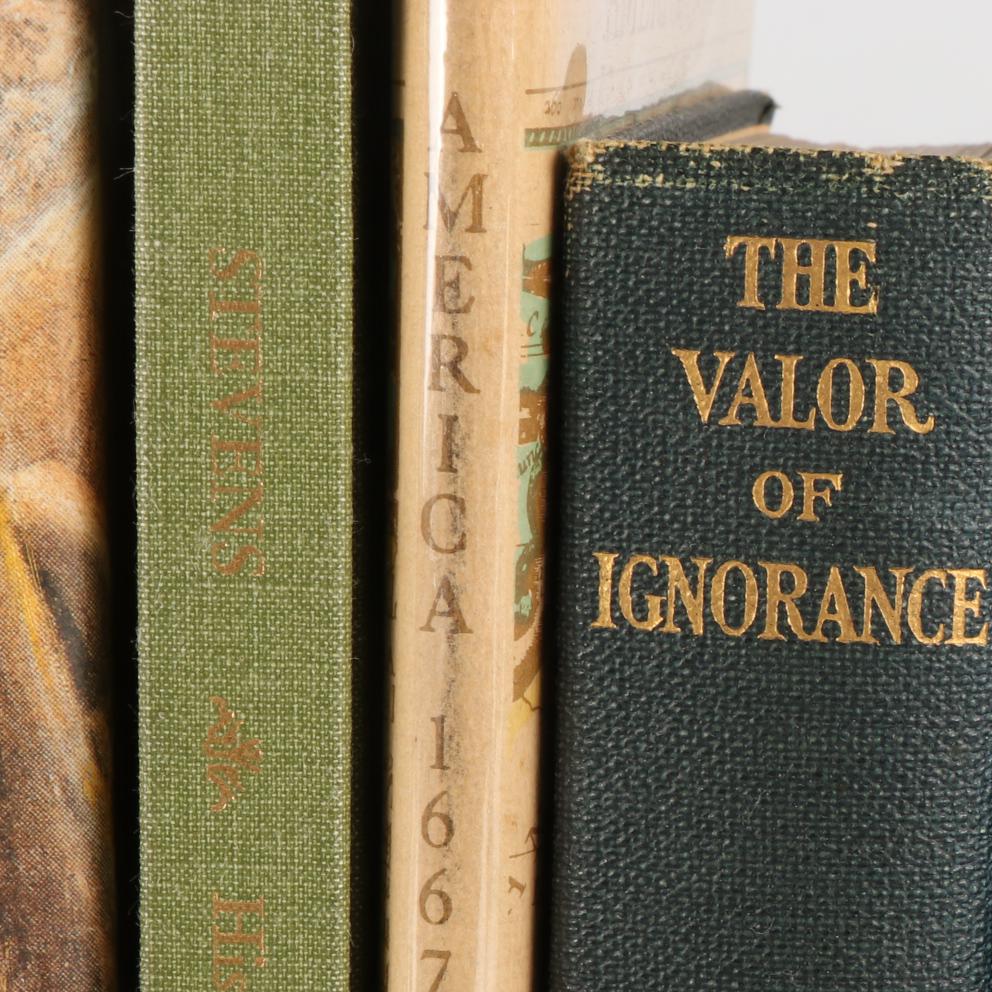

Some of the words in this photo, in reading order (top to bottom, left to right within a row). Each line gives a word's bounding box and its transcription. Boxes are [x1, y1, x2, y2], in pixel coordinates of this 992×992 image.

[724, 235, 878, 314] THE
[420, 92, 487, 635] AMERICA
[671, 348, 936, 434] VALOR
[208, 246, 266, 577] STEVENS
[751, 470, 843, 522] OF
[591, 551, 988, 647] IGNORANCE
